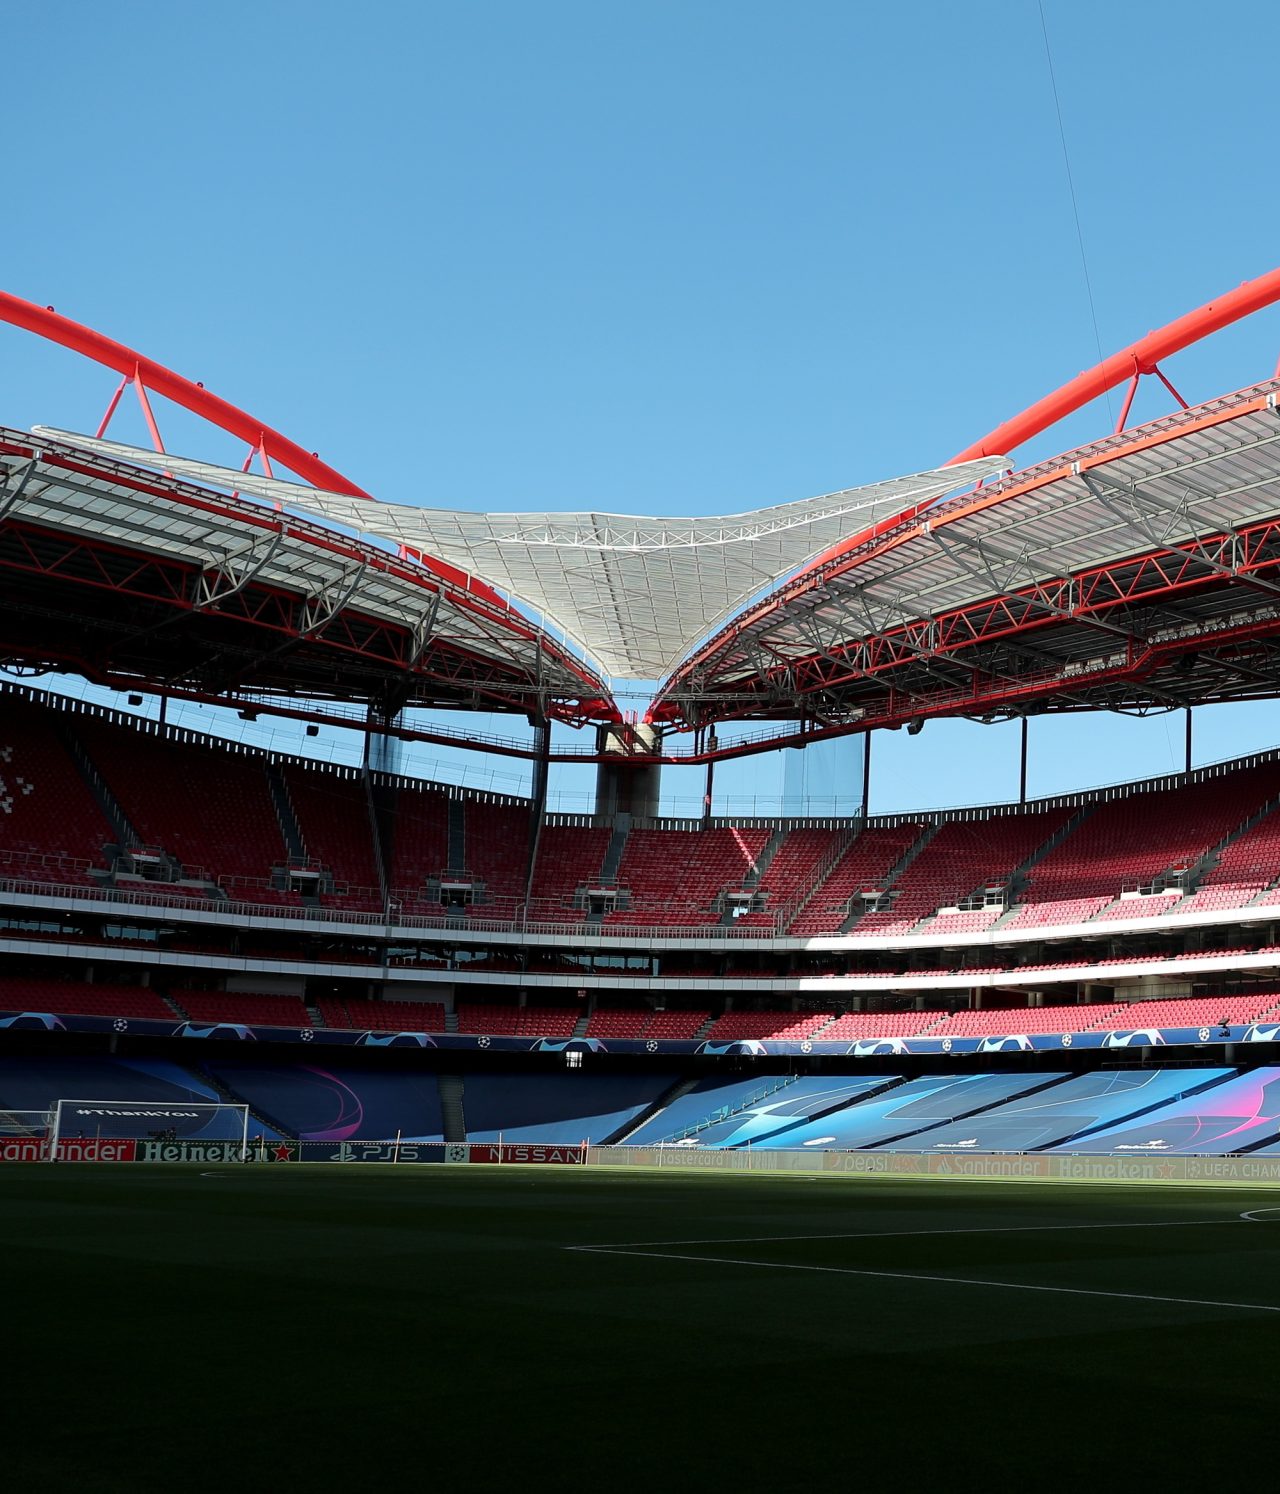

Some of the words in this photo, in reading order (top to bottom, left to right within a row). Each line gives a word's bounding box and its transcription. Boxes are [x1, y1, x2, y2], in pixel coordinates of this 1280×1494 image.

[76, 1109, 199, 1118] #ThankYou
[0, 1140, 126, 1162] antander
[143, 1141, 269, 1162] Heineken
[363, 1145, 418, 1160] PS5
[489, 1148, 580, 1163] NISSAN
[844, 1153, 888, 1172] pepsi
[955, 1156, 1040, 1176] Santander
[1059, 1159, 1153, 1178] Heineken
[1204, 1163, 1238, 1177] UEFA
